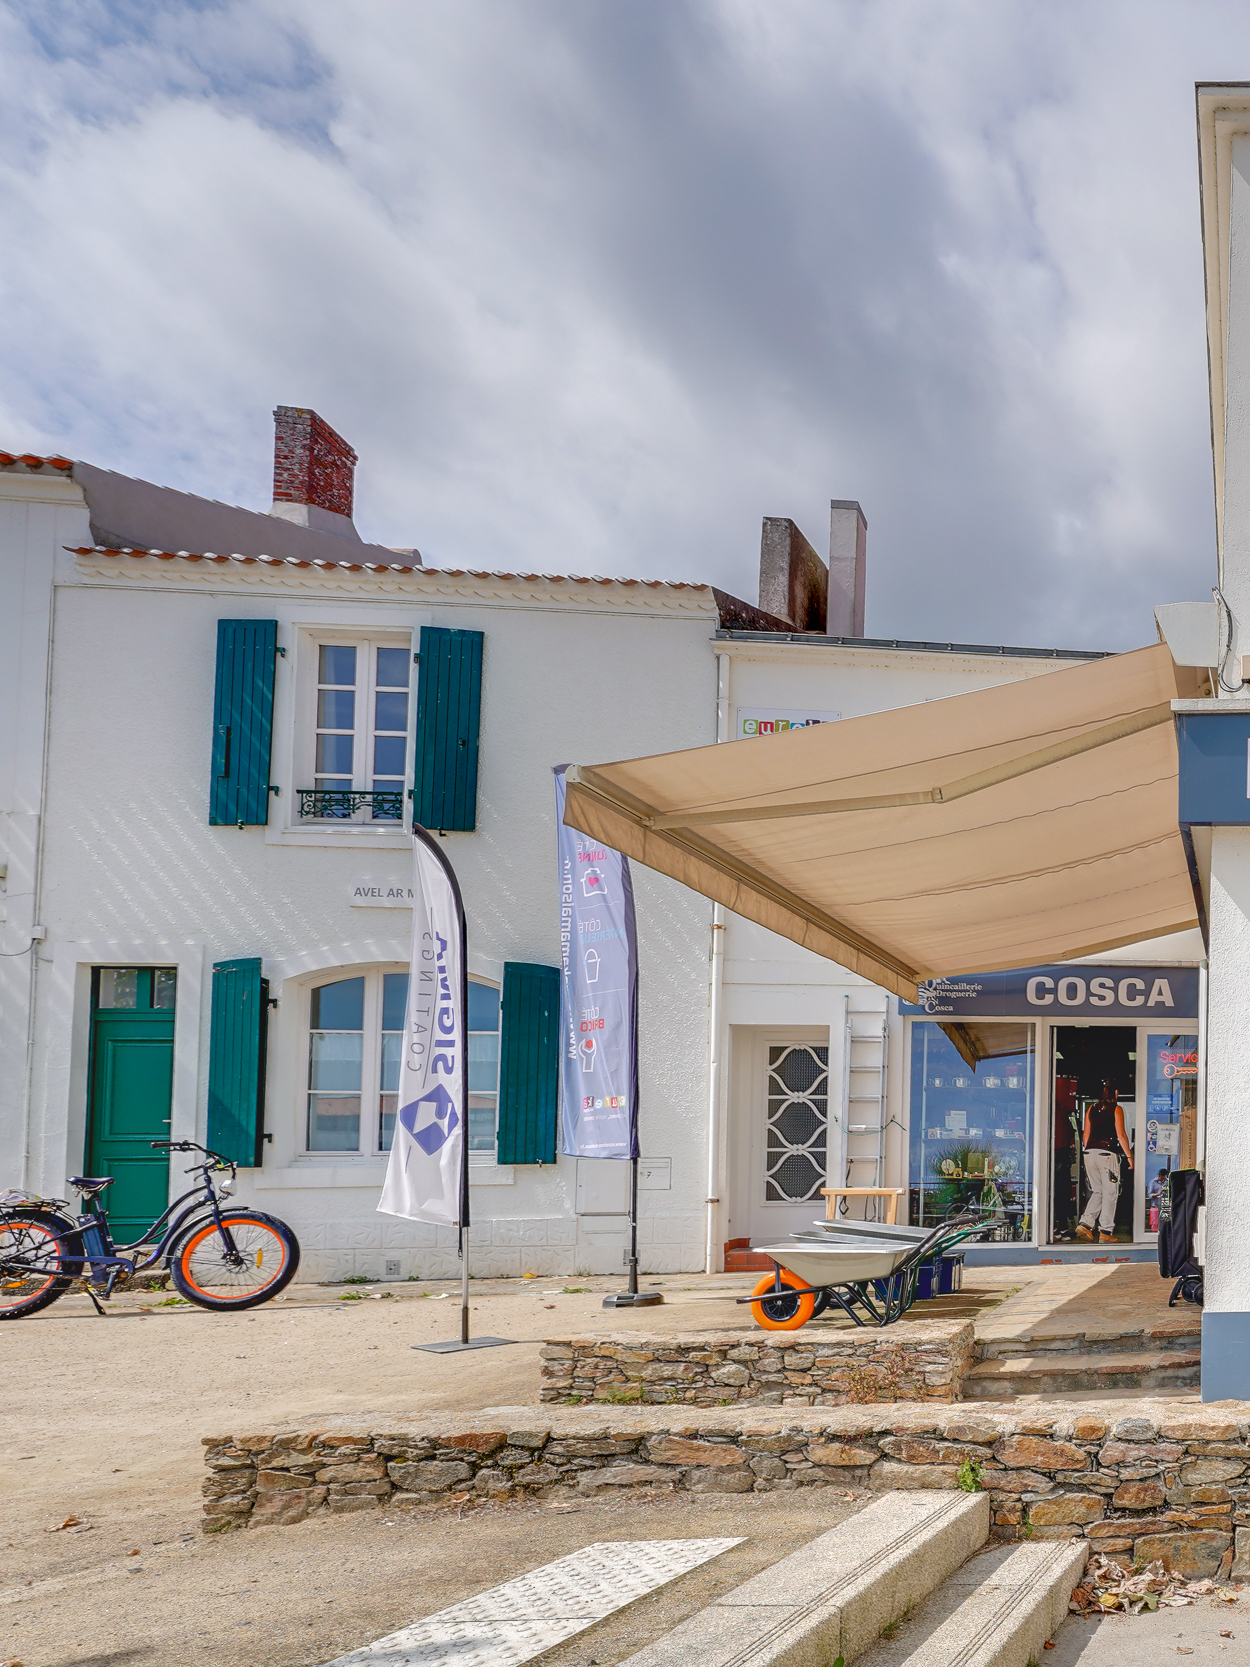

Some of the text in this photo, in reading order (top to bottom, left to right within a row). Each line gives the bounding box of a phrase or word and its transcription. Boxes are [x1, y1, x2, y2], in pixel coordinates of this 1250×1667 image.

[353, 887, 384, 898] AVEL
[386, 888, 404, 898] AR
[925, 979, 983, 991] Quincaillerie
[936, 990, 978, 998] Droguerie
[1025, 975, 1175, 1008] COSCA
[924, 1000, 954, 1013] Cosca
[1160, 1050, 1199, 1064] Servic
